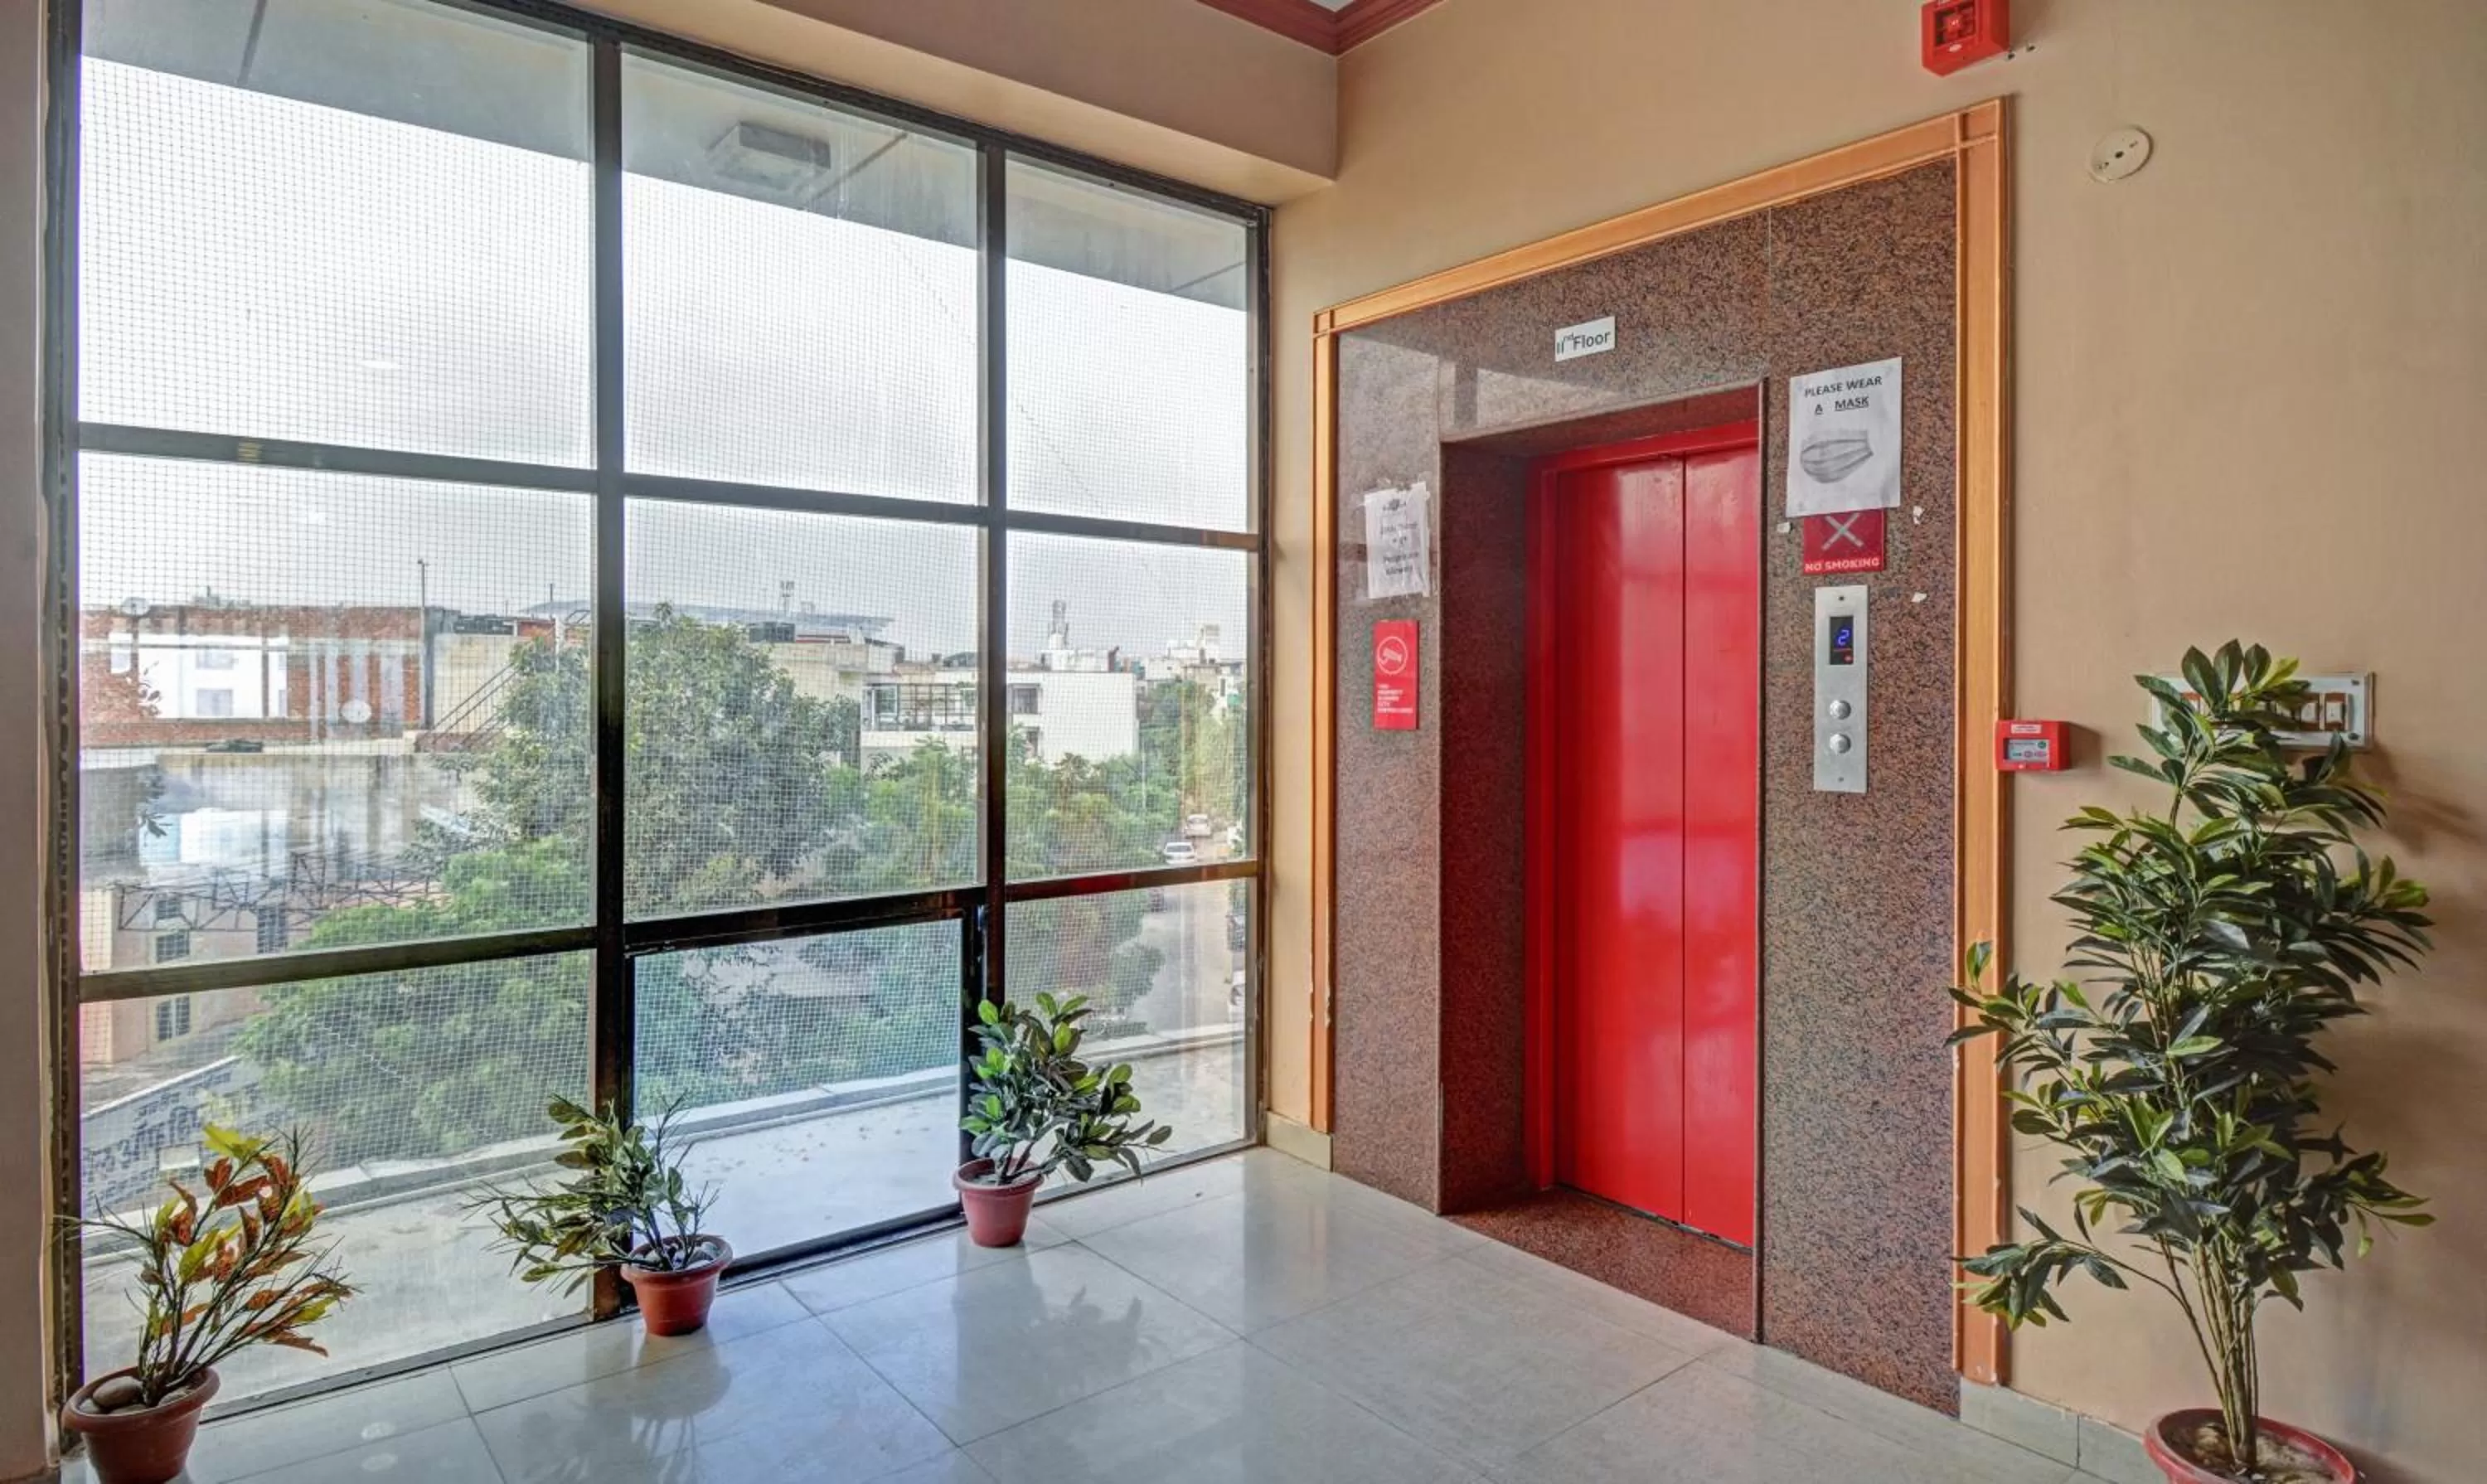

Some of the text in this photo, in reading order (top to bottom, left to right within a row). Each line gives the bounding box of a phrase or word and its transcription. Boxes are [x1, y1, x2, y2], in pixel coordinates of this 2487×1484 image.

[1573, 332, 1611, 352] Floor
[1805, 376, 1883, 398] PLEASE WEAR
[1815, 396, 1869, 415] A MASK
[1805, 557, 1880, 572] NO SMOKING
[1838, 629, 1849, 646] 2
